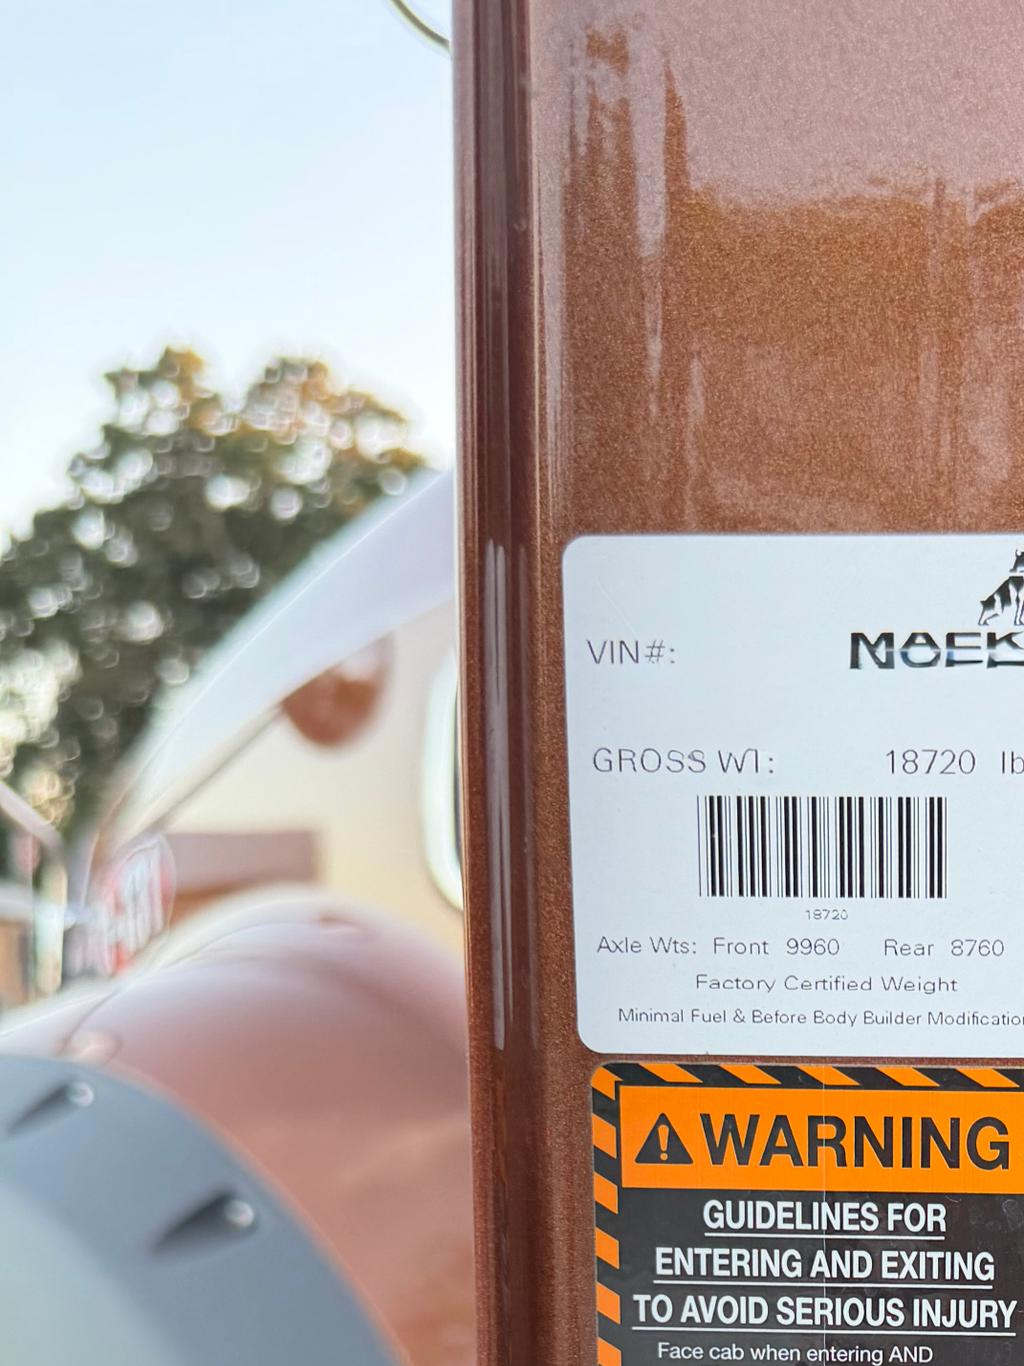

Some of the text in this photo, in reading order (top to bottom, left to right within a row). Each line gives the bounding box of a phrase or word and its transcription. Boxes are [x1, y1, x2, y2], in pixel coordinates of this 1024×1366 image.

[587, 640, 674, 664] VIN#:
[593, 748, 706, 773] GROSS
[887, 750, 975, 774] 18720
[1002, 752, 1024, 774] lb
[806, 909, 848, 920] 18720
[597, 936, 1004, 956] Axle Wts: Front 9960 Rear 8760
[697, 974, 957, 994] Factory Certified Weight
[619, 1008, 683, 1022] Minimal
[692, 1009, 726, 1023] Fuel
[733, 1008, 745, 1023] &
[752, 1010, 806, 1023] Before
[814, 1010, 857, 1027] Body
[864, 1011, 921, 1024] Builder
[700, 1113, 1009, 1170] WARNING
[703, 1199, 946, 1232] GUIDELINES FOR
[656, 1247, 994, 1280] ENTERING AND EXITING
[633, 1294, 1017, 1328] TO AVOID SERIOUS INJURY
[658, 1342, 933, 1366] Face cab when entering AND
